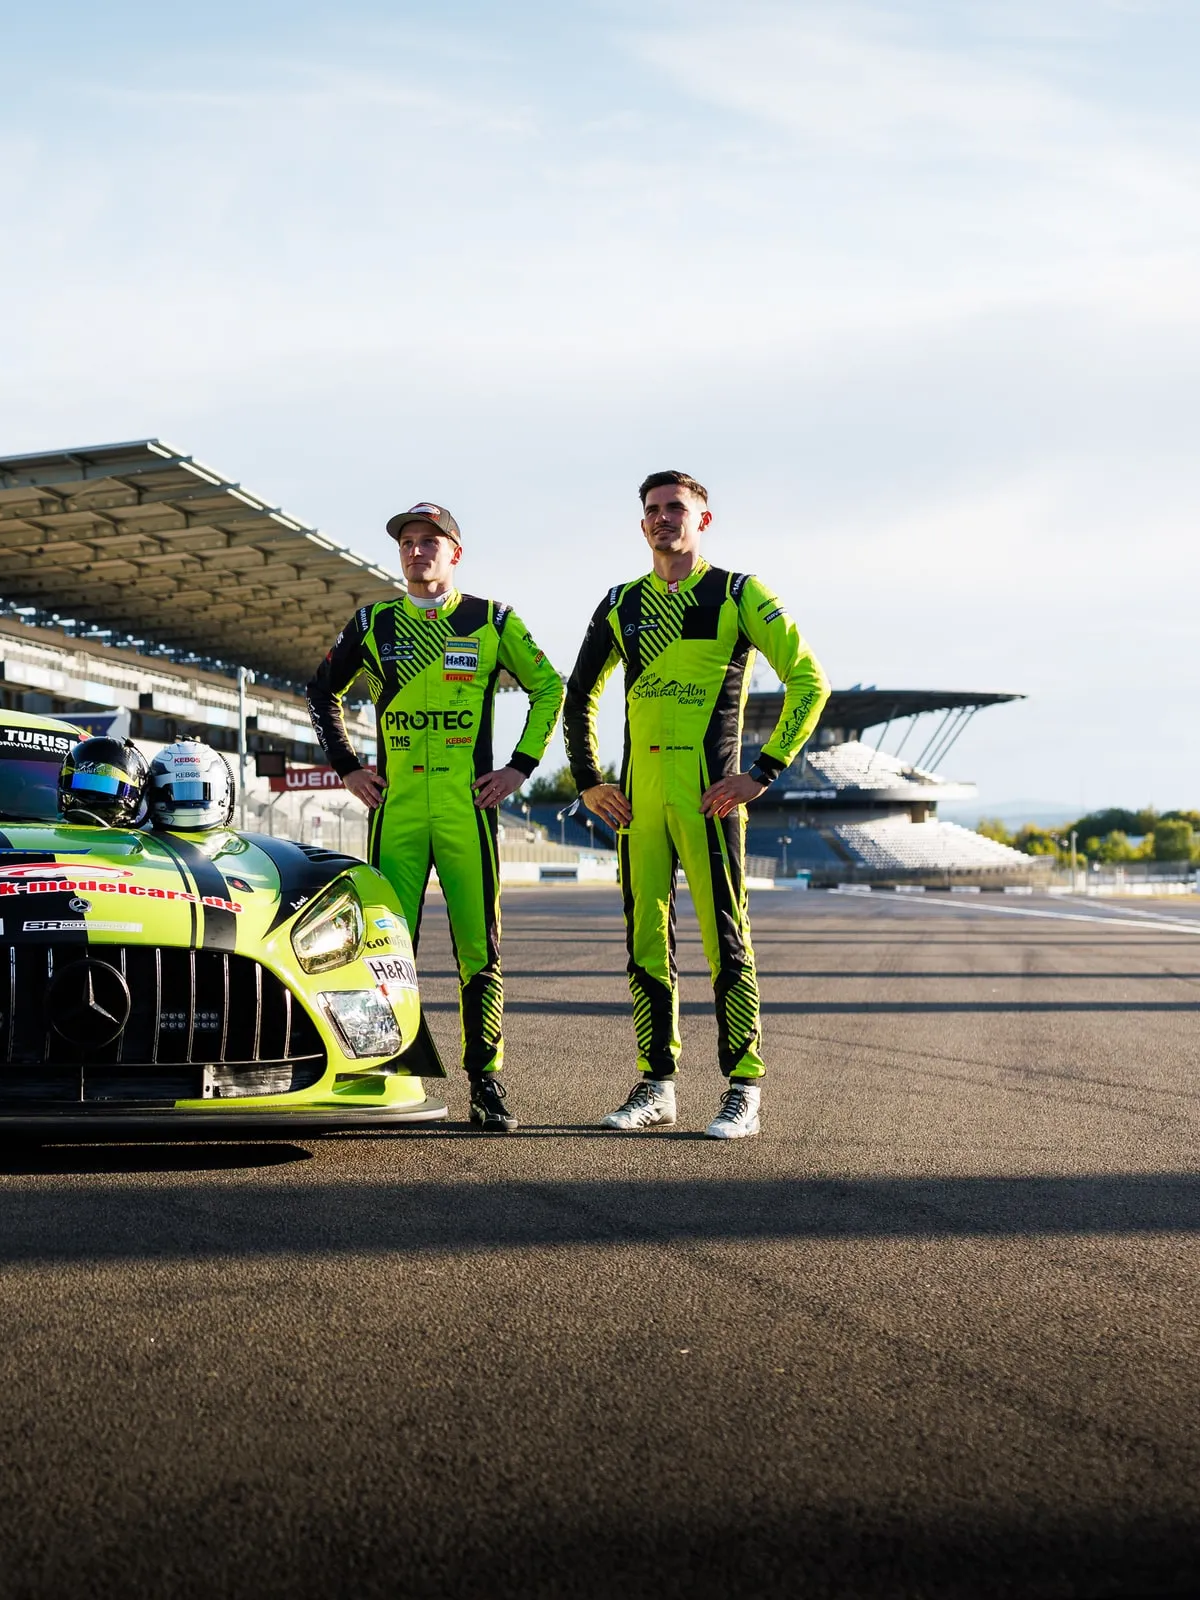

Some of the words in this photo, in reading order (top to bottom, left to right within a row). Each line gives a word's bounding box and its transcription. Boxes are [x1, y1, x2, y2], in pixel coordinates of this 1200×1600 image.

[446, 654, 466, 667] H&R
[678, 696, 705, 706] Racing
[386, 710, 473, 731] PROTEC
[4, 729, 79, 751] TURIS
[390, 736, 411, 747] TMS
[446, 737, 472, 745] KEBOS
[286, 770, 344, 788] WEM
[26, 921, 62, 930] SR
[370, 961, 407, 981] H&R
